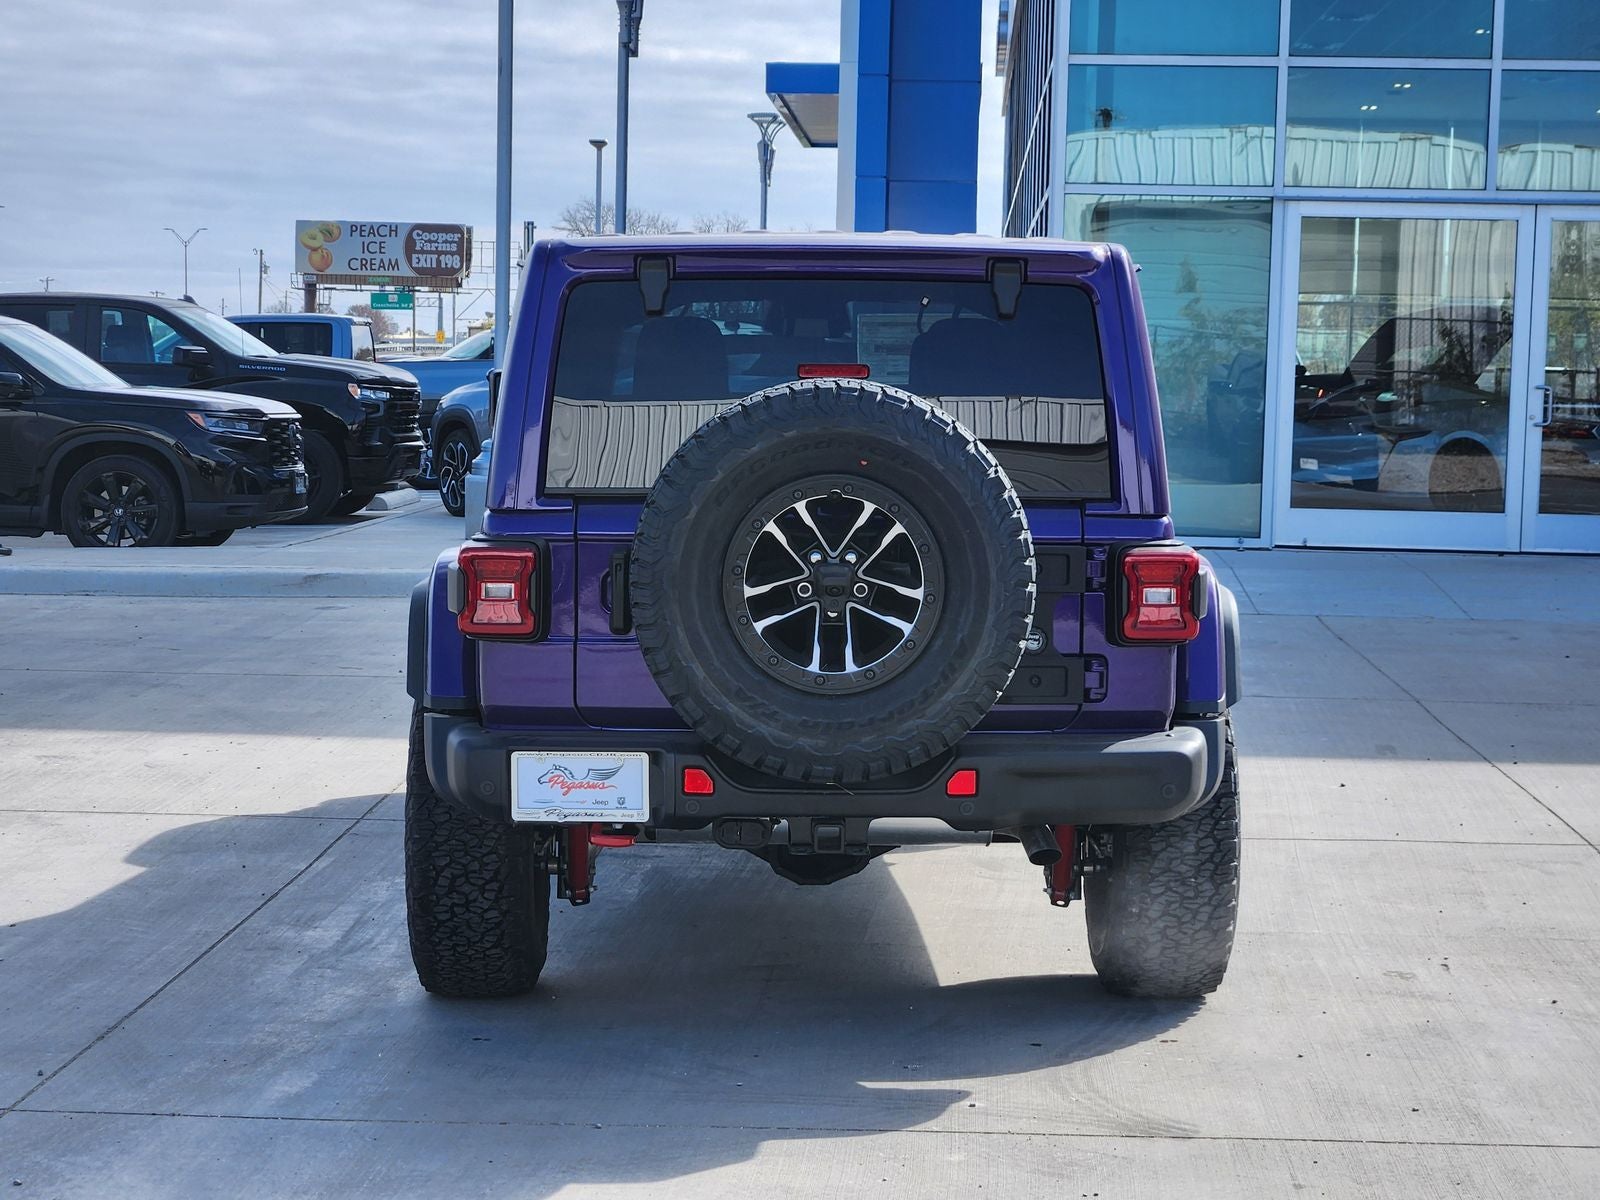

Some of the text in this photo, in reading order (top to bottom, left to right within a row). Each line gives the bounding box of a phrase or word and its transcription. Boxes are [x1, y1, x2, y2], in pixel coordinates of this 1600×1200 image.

[350, 224, 399, 238] PEACH
[412, 230, 462, 243] Cooper
[361, 240, 387, 255] ICE
[415, 240, 458, 252] Farms
[347, 258, 400, 272] CREAM
[411, 254, 461, 270] EXIT 198
[548, 774, 617, 796] Pegasus
[544, 808, 615, 819] Pegasus
